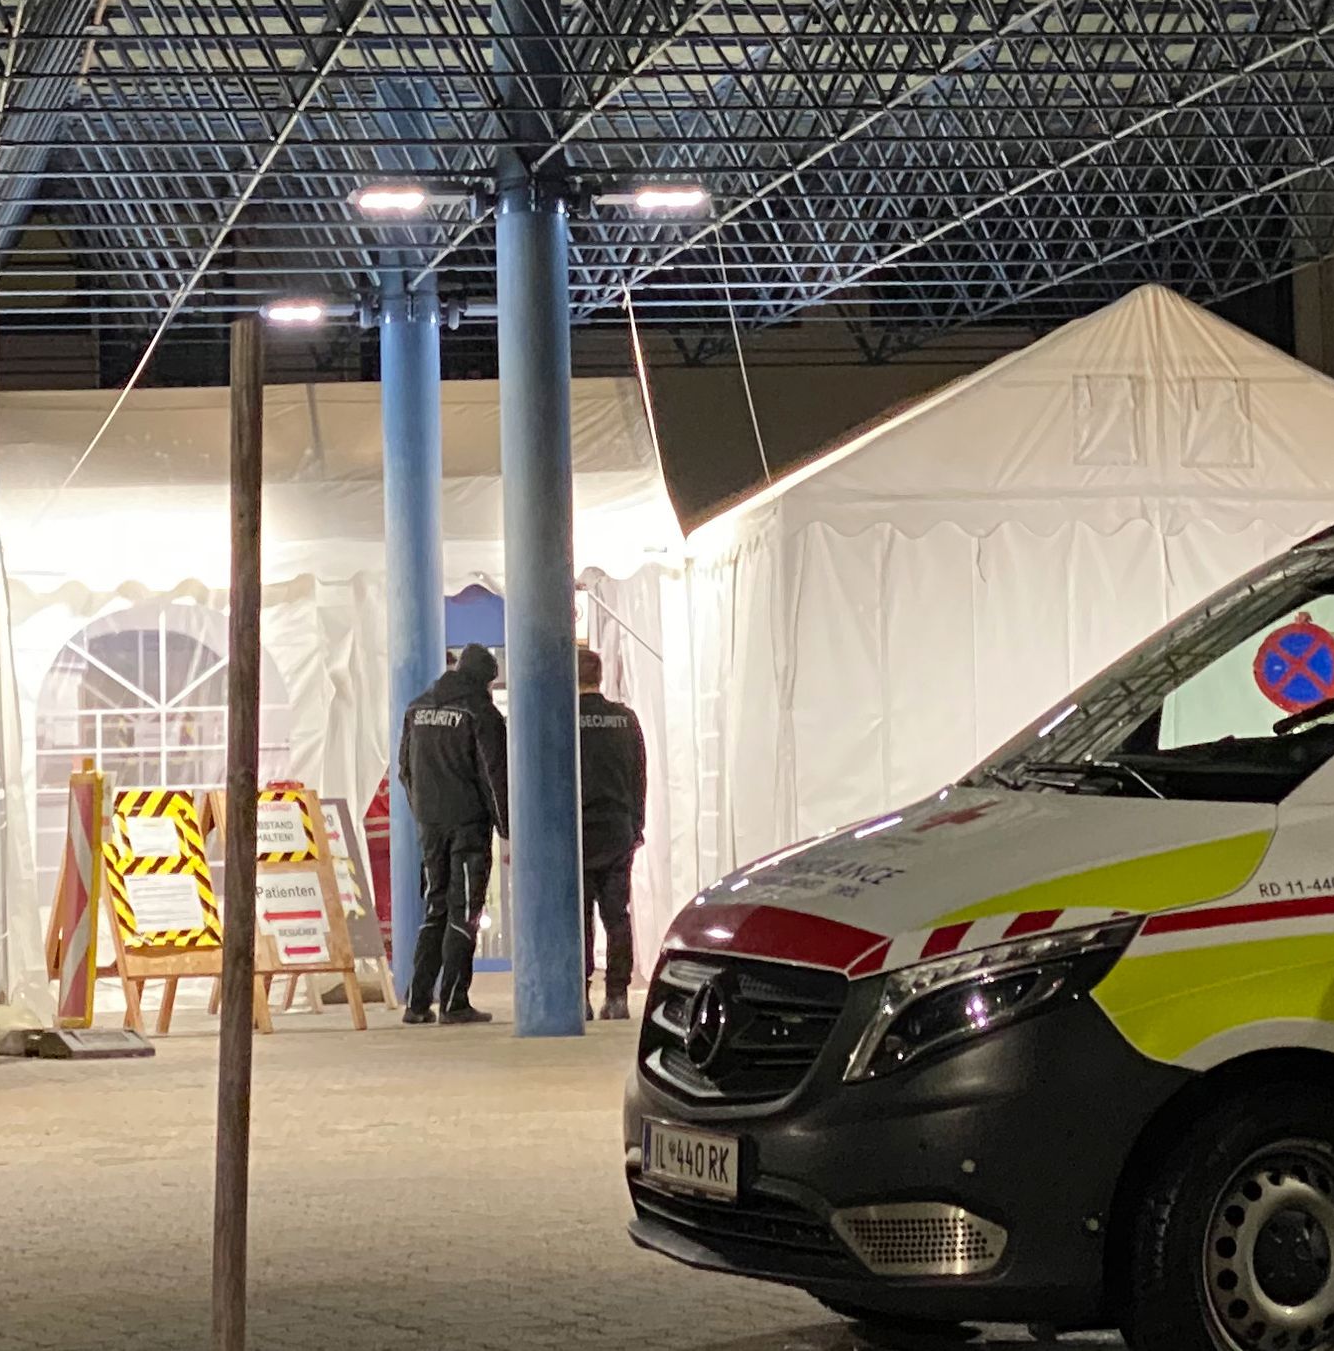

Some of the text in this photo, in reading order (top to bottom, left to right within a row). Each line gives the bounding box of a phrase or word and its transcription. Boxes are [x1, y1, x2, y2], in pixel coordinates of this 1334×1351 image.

[414, 710, 463, 728] SECURITY
[580, 714, 629, 728] SECURITY
[257, 821, 294, 830] BSTAND
[255, 885, 316, 899] Patienten
[1259, 882, 1282, 898] RD
